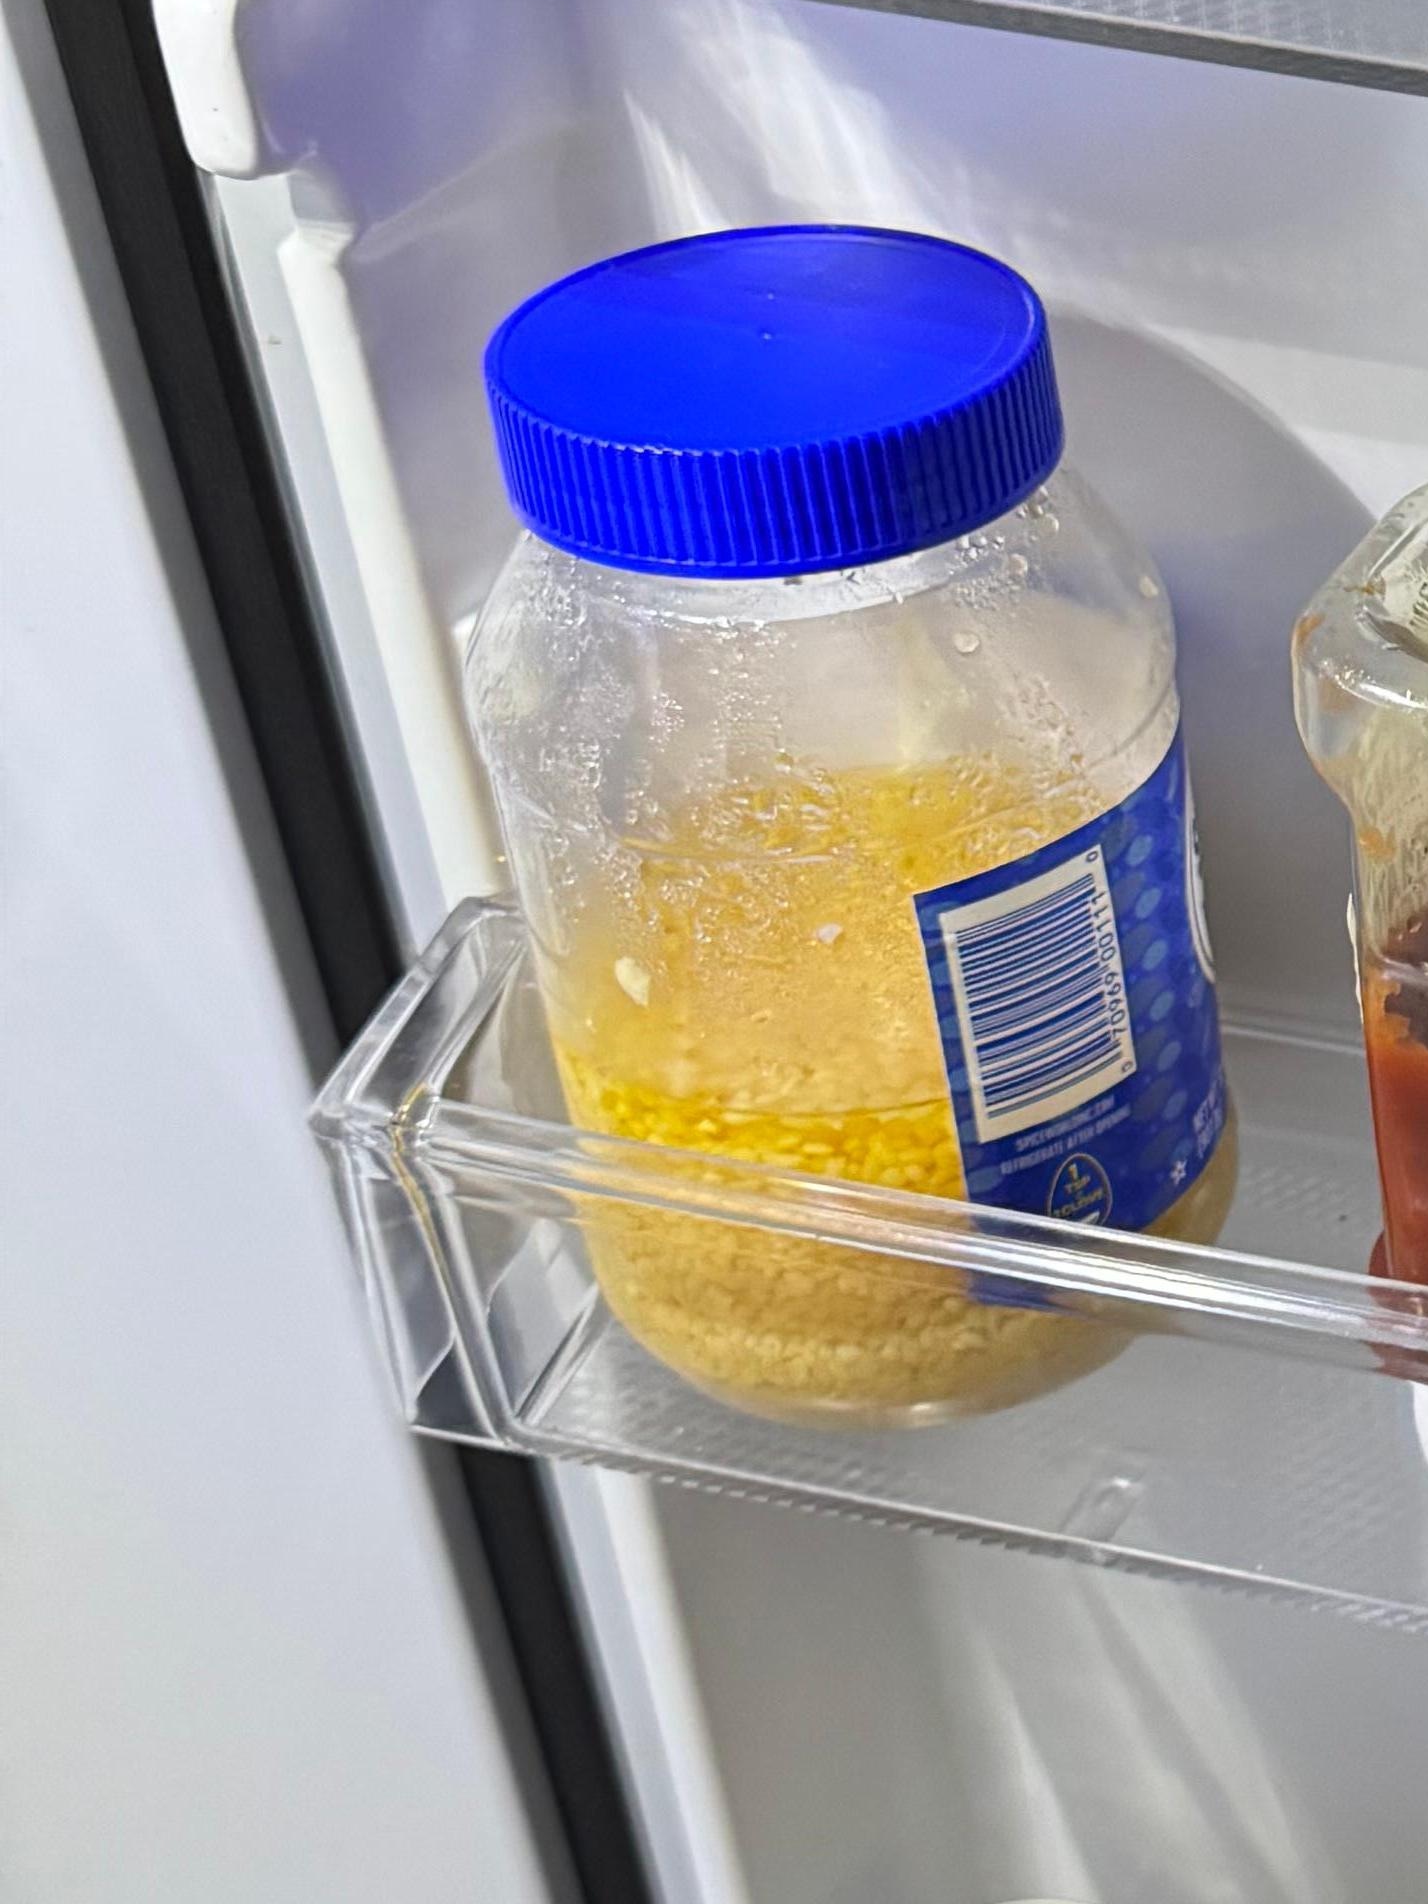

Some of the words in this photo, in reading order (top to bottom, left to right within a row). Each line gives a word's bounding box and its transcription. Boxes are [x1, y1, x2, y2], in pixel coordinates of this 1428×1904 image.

[1085, 850, 1100, 863] 0
[1091, 891, 1117, 963] 00111
[1104, 970, 1128, 1041] 70969
